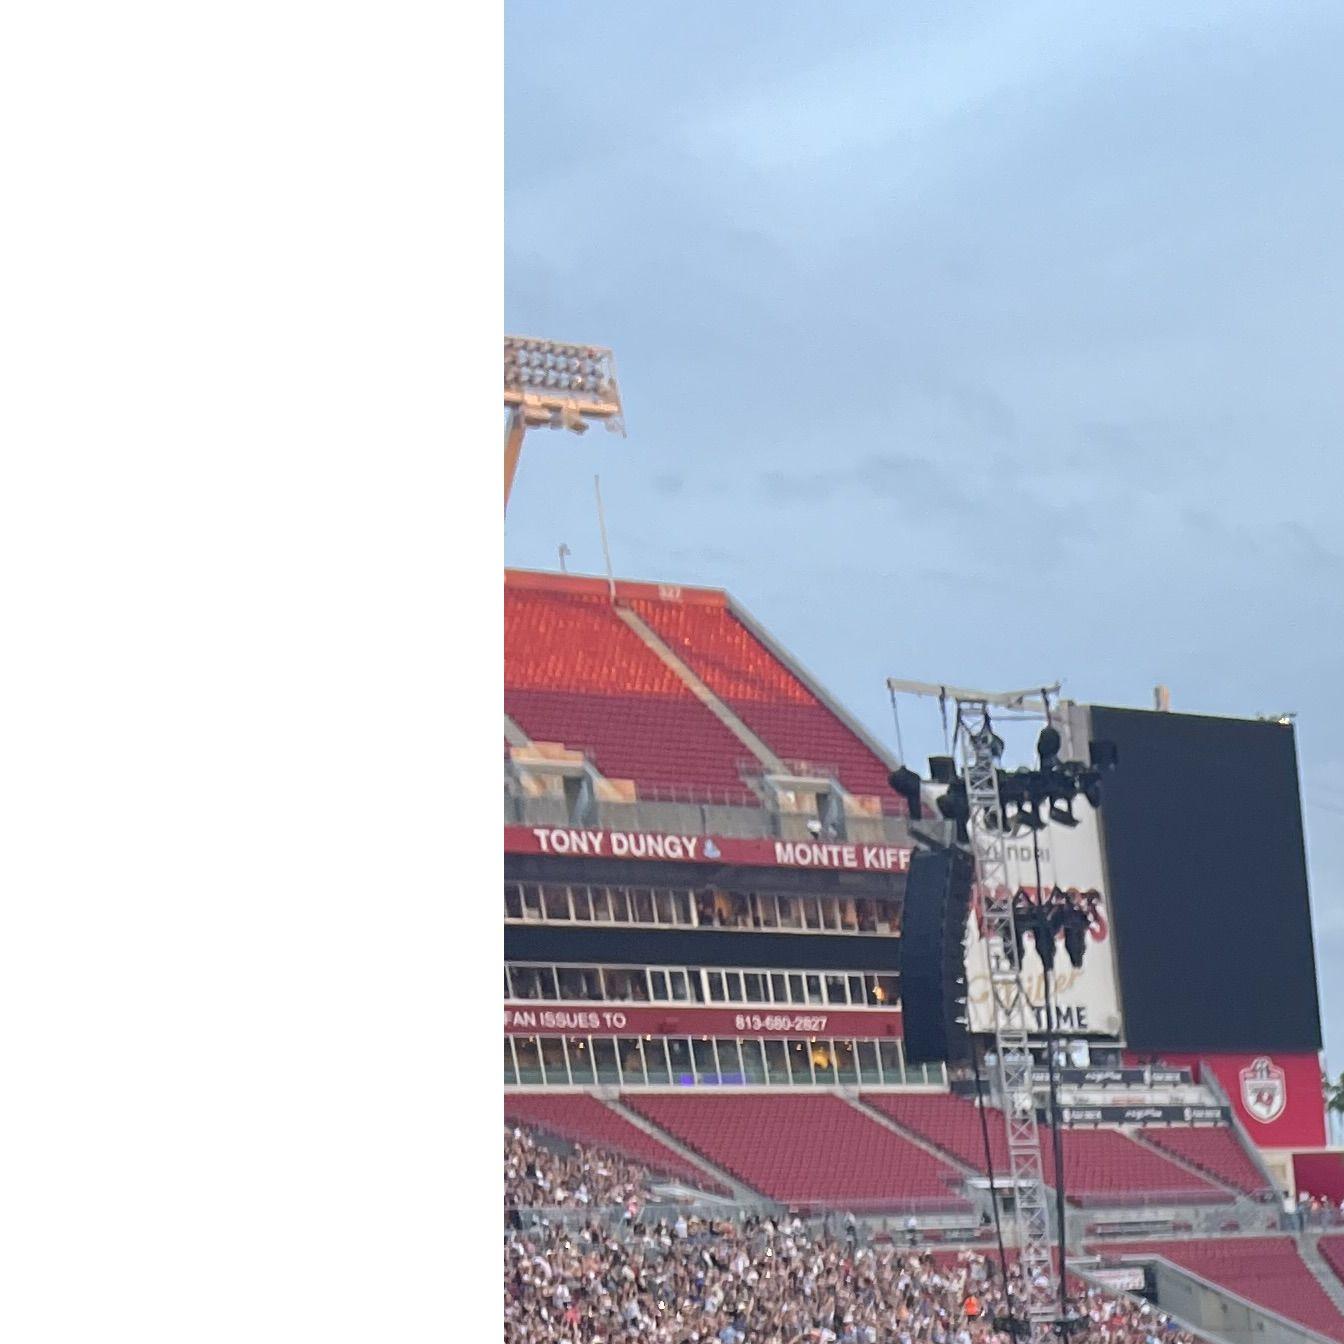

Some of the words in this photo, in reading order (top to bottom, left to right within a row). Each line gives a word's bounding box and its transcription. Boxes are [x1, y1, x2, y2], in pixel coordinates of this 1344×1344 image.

[533, 828, 603, 855] TONY
[611, 832, 698, 859] DUNGY
[775, 842, 858, 868] MONTE
[504, 1011, 536, 1027] FAN
[540, 1011, 600, 1029] ISSUES
[602, 1012, 627, 1028] TO
